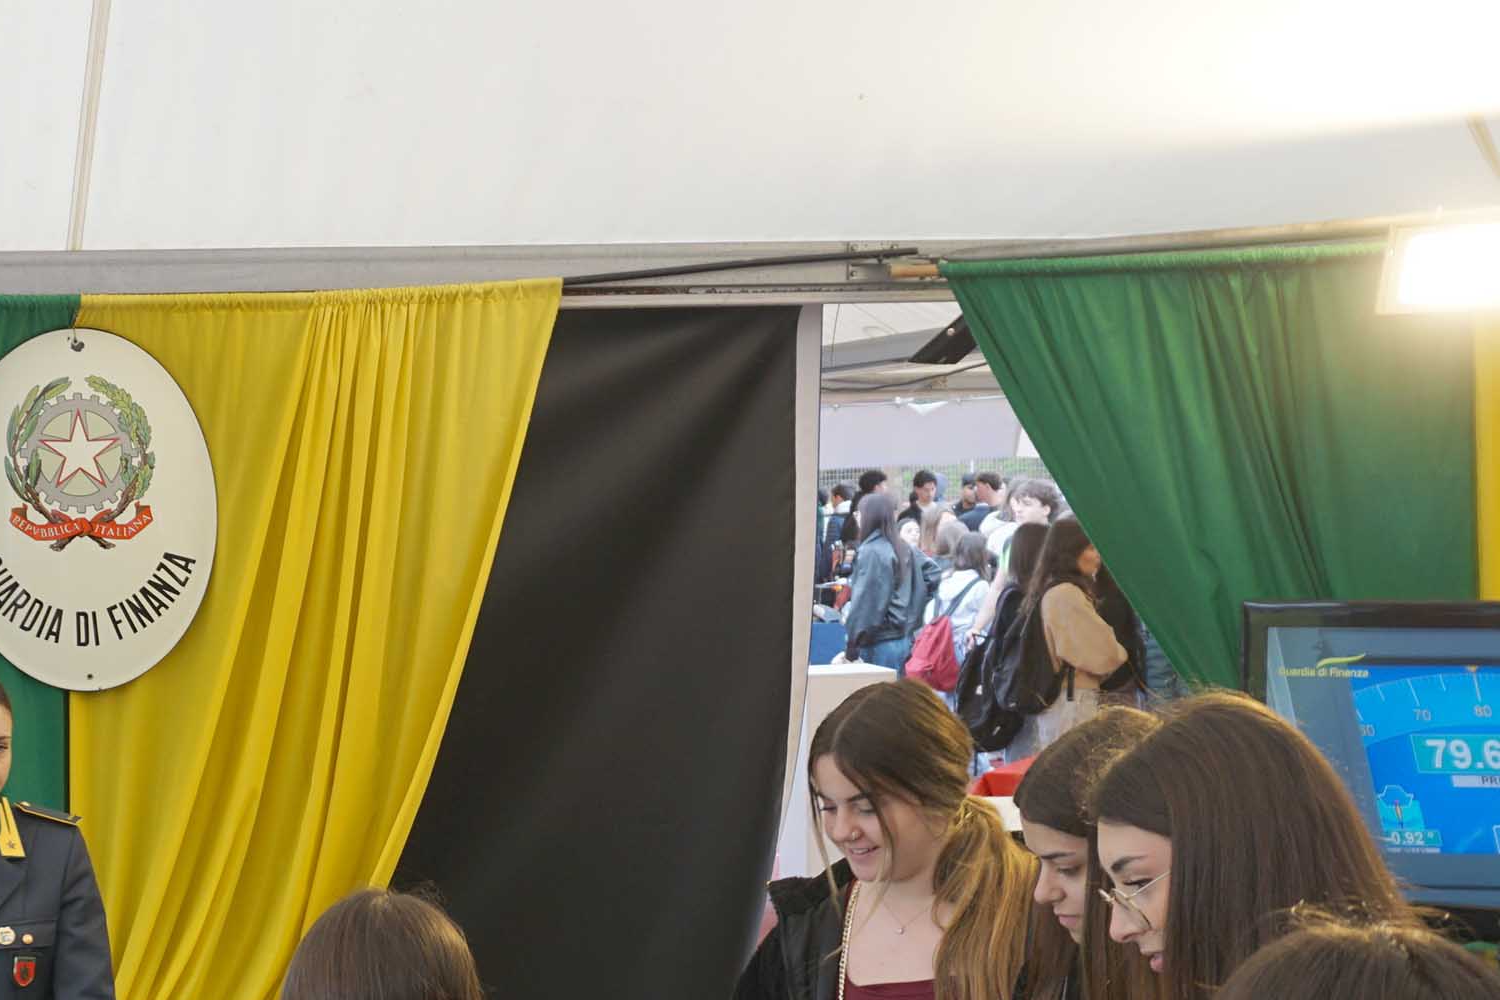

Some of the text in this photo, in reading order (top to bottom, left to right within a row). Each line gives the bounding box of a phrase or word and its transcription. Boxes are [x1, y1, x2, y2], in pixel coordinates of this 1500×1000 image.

[93, 514, 152, 538] ITALIANA
[76, 611, 100, 647] DI
[106, 551, 197, 640] FINANZA
[1278, 666, 1369, 679] Guardia di Finanza
[1413, 709, 1432, 721] 70
[1474, 704, 1492, 718] 80
[1425, 738, 1500, 769] 79.6
